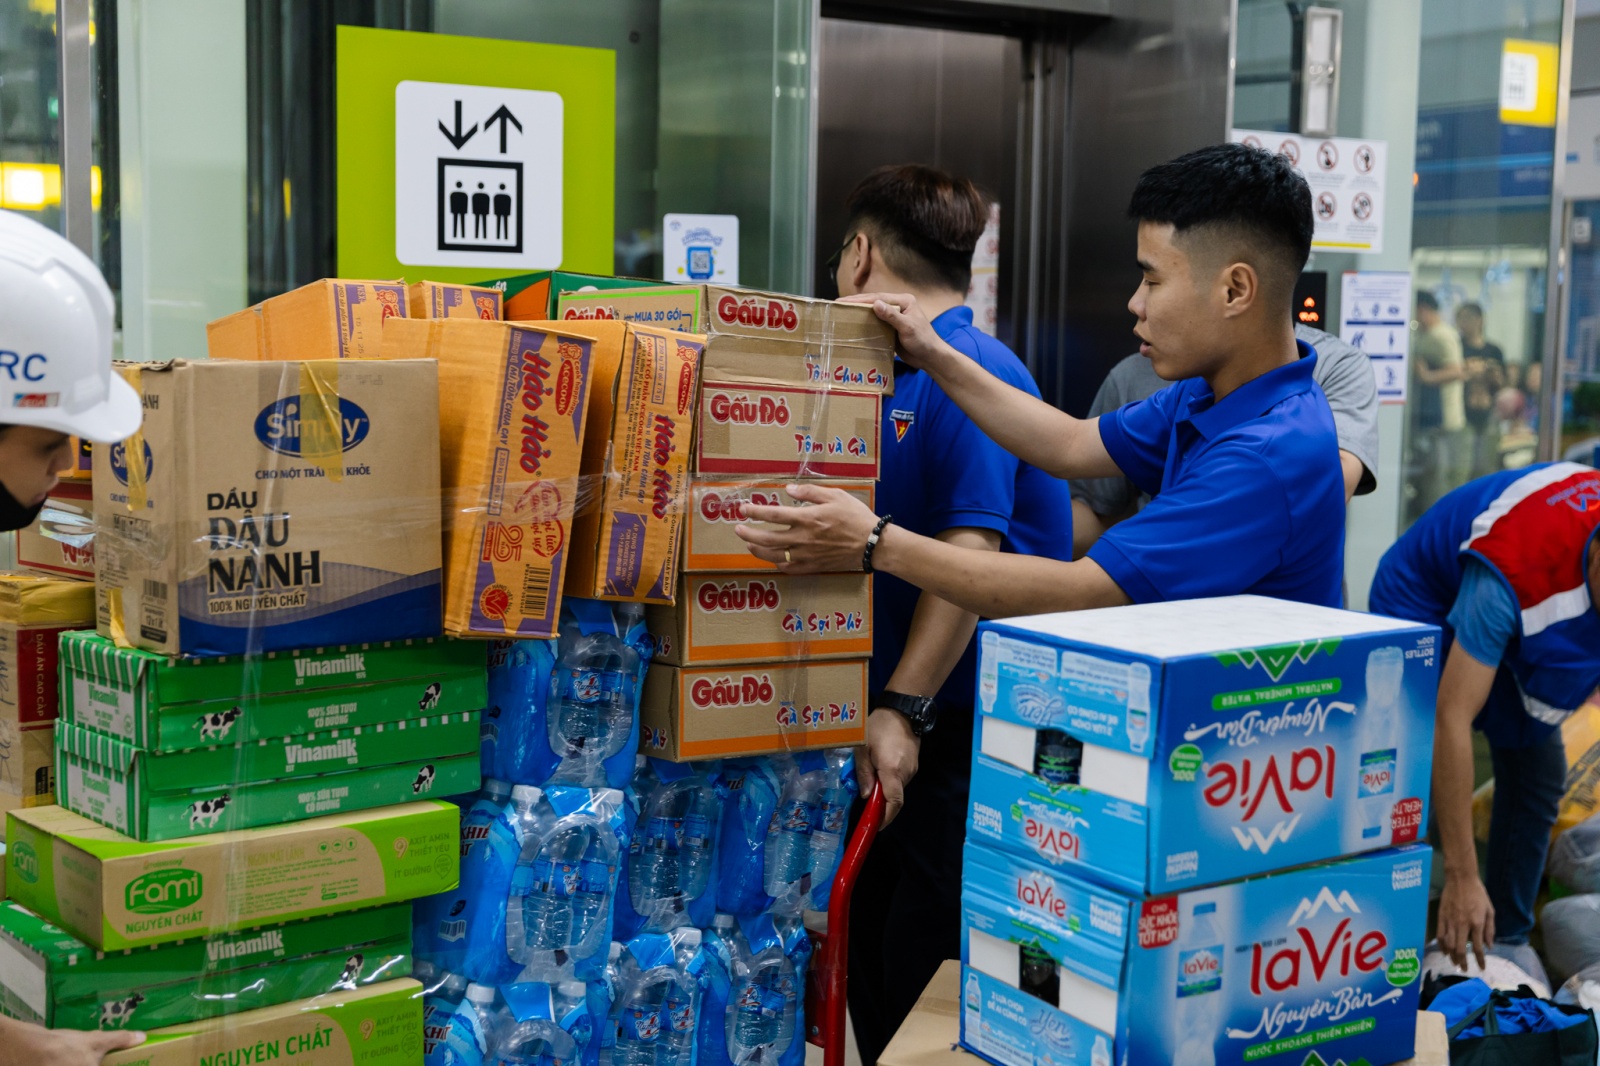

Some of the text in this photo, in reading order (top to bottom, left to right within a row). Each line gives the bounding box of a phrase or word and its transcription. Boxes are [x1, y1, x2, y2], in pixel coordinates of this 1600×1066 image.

[634, 307, 682, 322] MUA 30 GÓI
[645, 357, 651, 368] TY
[567, 360, 582, 417] Cook happiness
[834, 365, 863, 384] Chua
[867, 368, 890, 389] Cay
[505, 380, 517, 401] TÔM
[266, 403, 361, 443] Simply
[501, 401, 513, 426] CHUA
[514, 350, 558, 475] Hảo Hảo
[498, 427, 510, 445] CAY
[795, 433, 868, 457] Tôm và Gà
[255, 470, 278, 480] CHO
[280, 467, 301, 481] MỘT
[346, 463, 371, 476] KHỎE
[648, 413, 679, 520] Hảo Hảo
[207, 508, 290, 551] ĐẬU
[491, 523, 524, 564] 25
[627, 550, 635, 570] TRONG
[209, 589, 307, 613] 100% NGUYÊN CHẤT
[782, 611, 863, 636] Gà Sợi Phở
[295, 653, 366, 677] Vinamilk
[1405, 647, 1435, 660] BOTTLES
[1423, 657, 1434, 667] 24
[1221, 681, 1332, 705] NATURAL MINERAL WATER
[776, 702, 858, 728] Gà Sợi Phở
[1203, 698, 1343, 747] Nguyên Bản
[285, 738, 358, 764] Vinamilk
[1203, 745, 1336, 822] laVie
[1392, 799, 1423, 815] HEALTH
[1392, 812, 1422, 829] BETTER
[394, 832, 450, 860] 9 AXIT AMIN
[1391, 867, 1422, 881] Nestlé
[1391, 877, 1422, 891] Waters
[1017, 877, 1067, 918] laVie
[126, 909, 203, 935] NGUYÊN CHẤT
[206, 929, 284, 963] Vinamilk
[1250, 917, 1387, 996] laVie
[1184, 955, 1219, 975] laVie
[360, 1011, 418, 1040] 9 AXIT AMIN
[1244, 986, 1388, 1040] Nguyên Bản
[285, 1022, 334, 1055] CHẤT
[1246, 1043, 1273, 1058] NƯỚC
